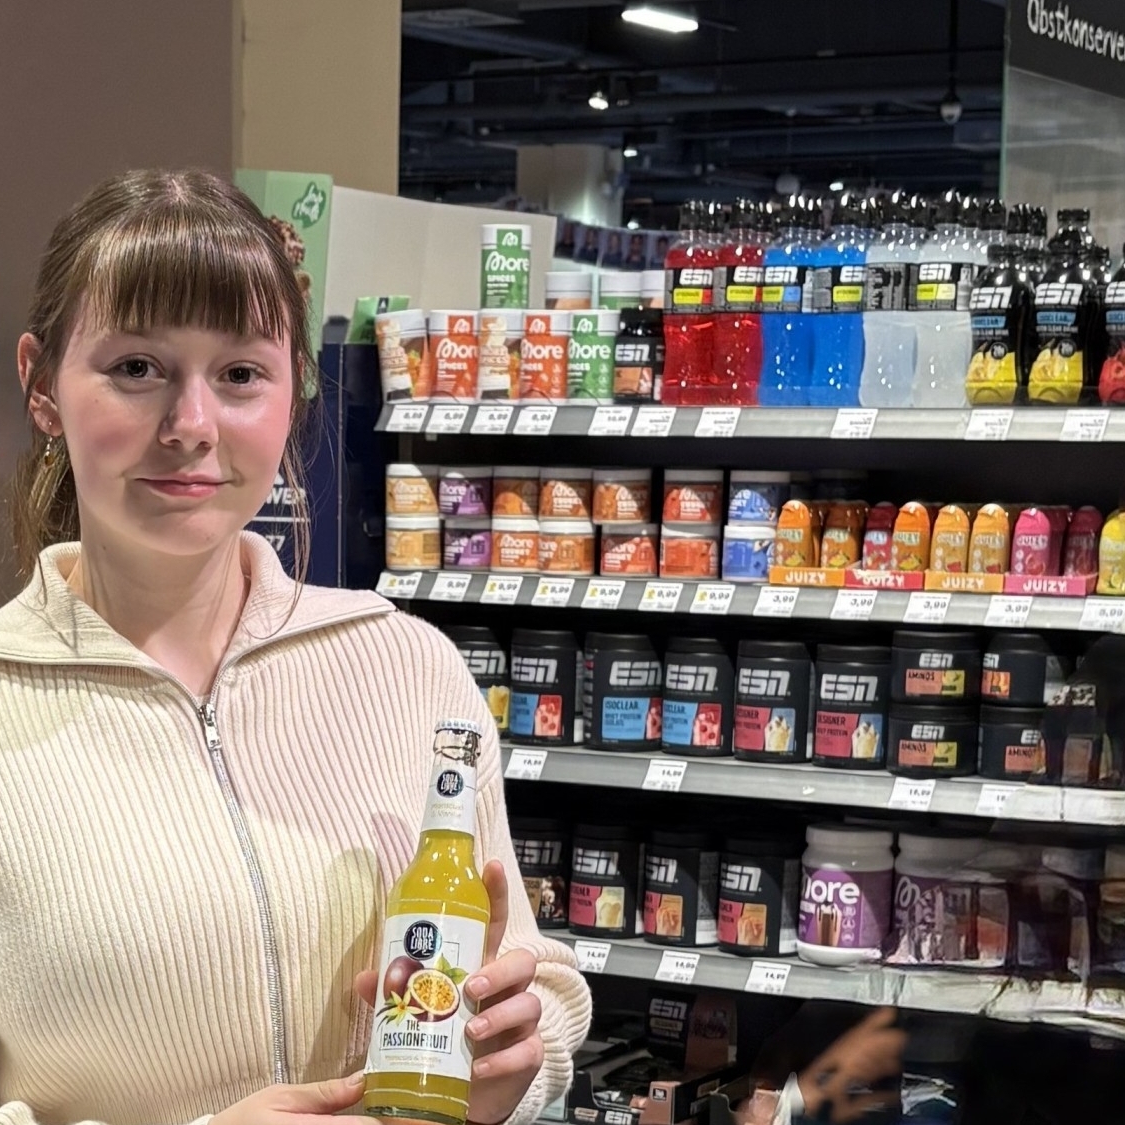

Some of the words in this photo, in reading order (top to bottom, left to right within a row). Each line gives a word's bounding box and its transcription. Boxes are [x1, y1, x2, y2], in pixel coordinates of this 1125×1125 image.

[1027, 0, 1125, 62] Obstkonserve
[436, 338, 477, 358] Mor
[785, 571, 826, 583] JUIZY
[862, 573, 905, 587] JUIZY
[941, 576, 985, 589] JUIZY
[1023, 580, 1068, 593] JUIZY
[919, 653, 953, 668] ESN
[666, 664, 718, 692] ESN
[738, 668, 791, 697] ESN
[820, 673, 879, 702] ESN
[911, 725, 945, 740] ESN
[411, 926, 434, 939] SODA
[410, 936, 434, 951] LIBRE
[406, 1019, 421, 1032] THE
